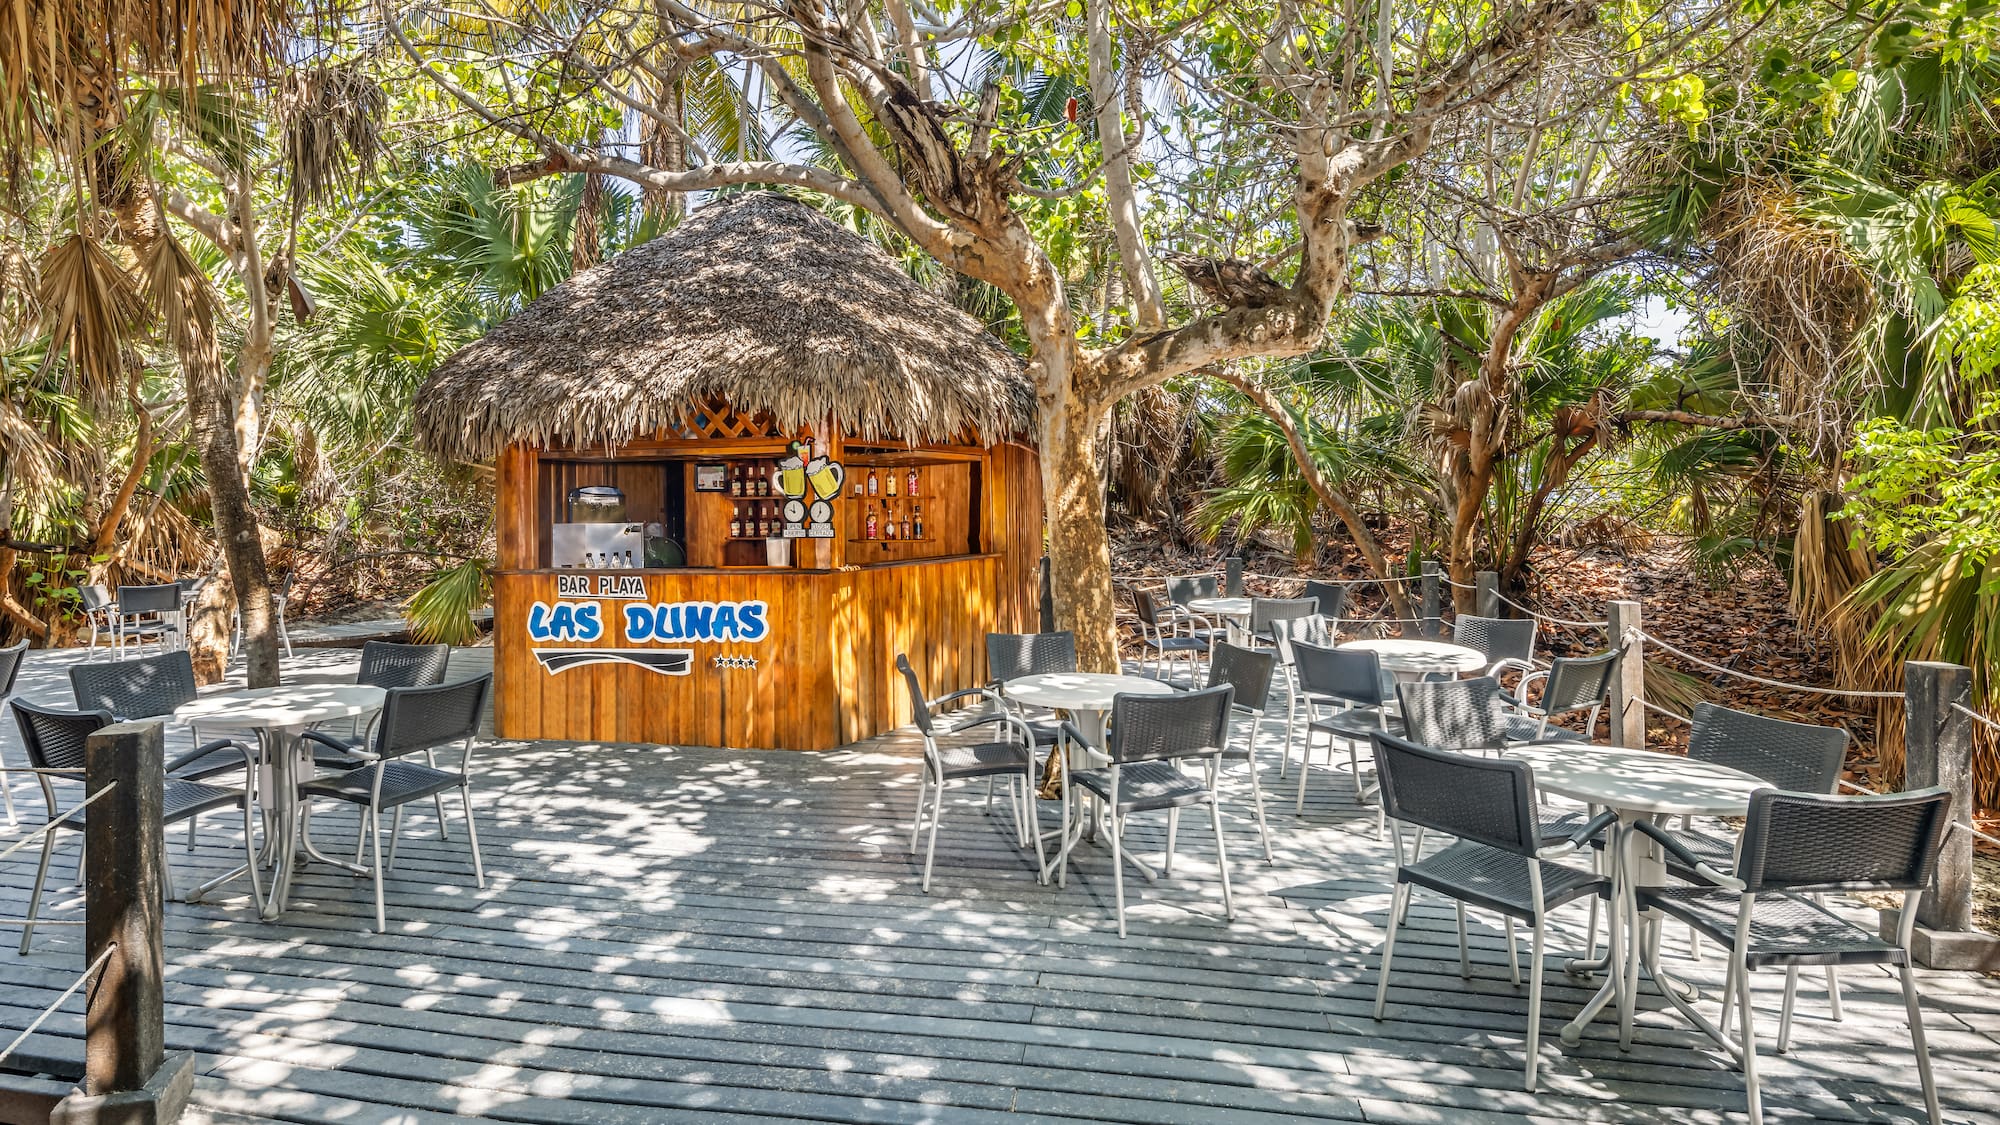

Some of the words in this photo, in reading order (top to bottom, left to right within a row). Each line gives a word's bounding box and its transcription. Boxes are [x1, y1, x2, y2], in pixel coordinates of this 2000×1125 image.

[559, 576, 588, 594] BAR
[600, 576, 645, 595] PLAYA
[529, 605, 600, 639] LAS
[626, 604, 765, 639] DUNAS
